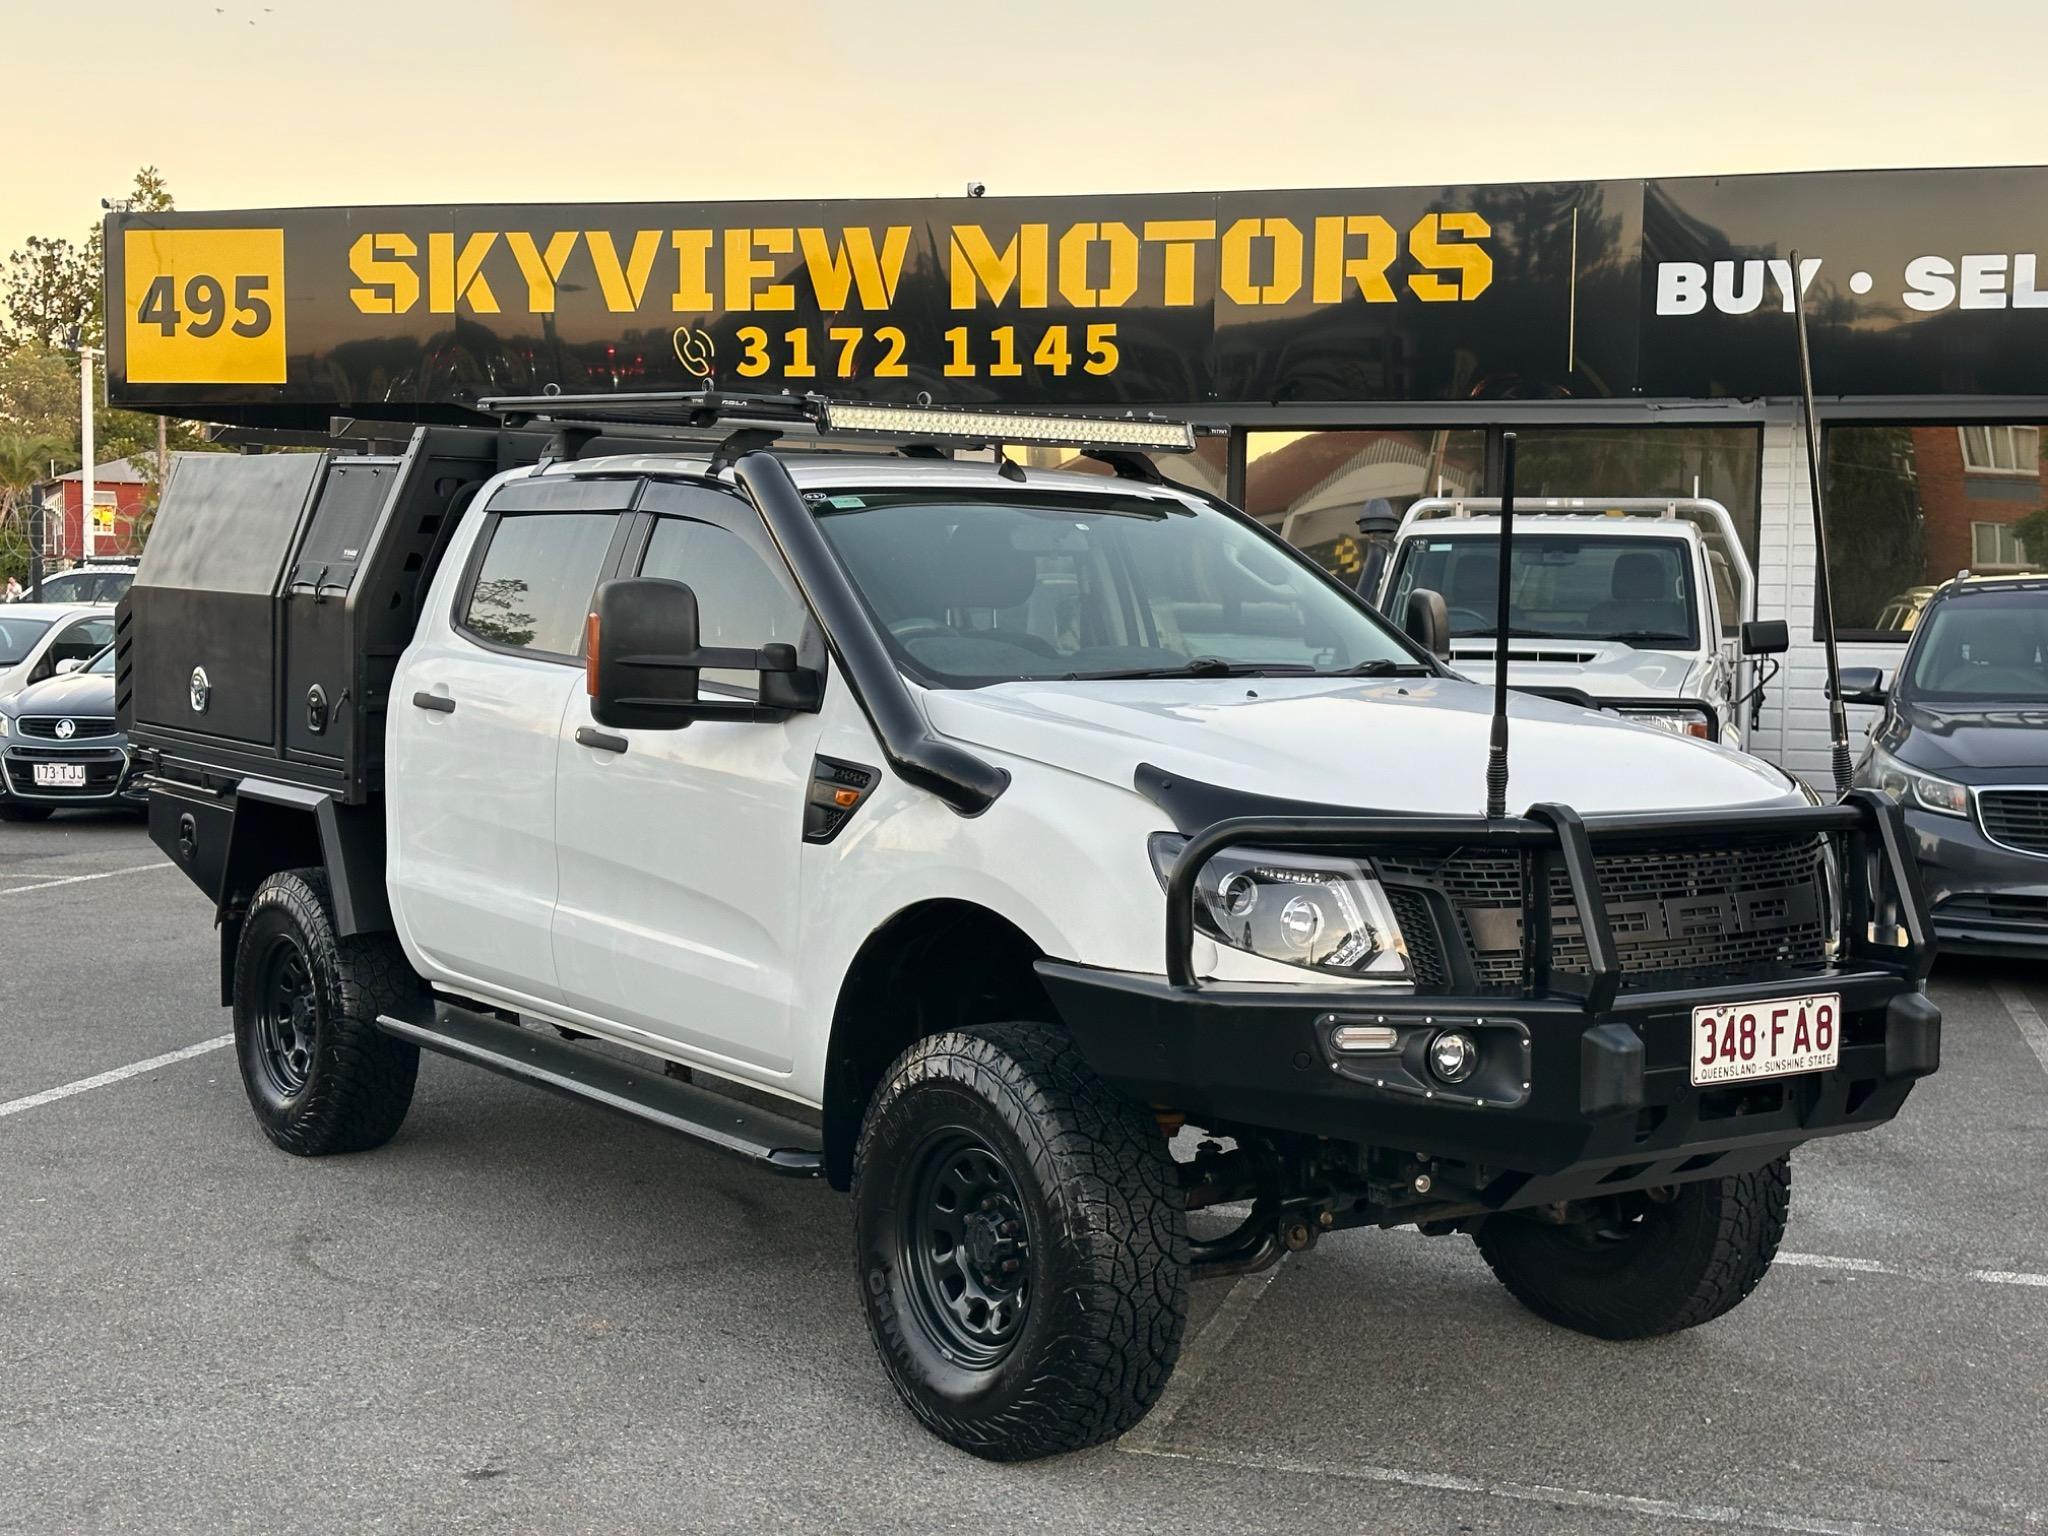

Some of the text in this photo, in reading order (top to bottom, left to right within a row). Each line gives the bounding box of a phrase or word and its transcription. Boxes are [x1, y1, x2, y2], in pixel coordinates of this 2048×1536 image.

[349, 212, 1493, 314] SKYVIEW MOTORS
[1656, 257, 1823, 316] BUY
[137, 275, 272, 339] 495
[736, 323, 1120, 378] 3172 1145
[1701, 1062, 1757, 1080] QUEENSLAND
[1764, 1056, 1805, 1072] SUNSHINE
[1808, 1053, 1832, 1067] STATE
